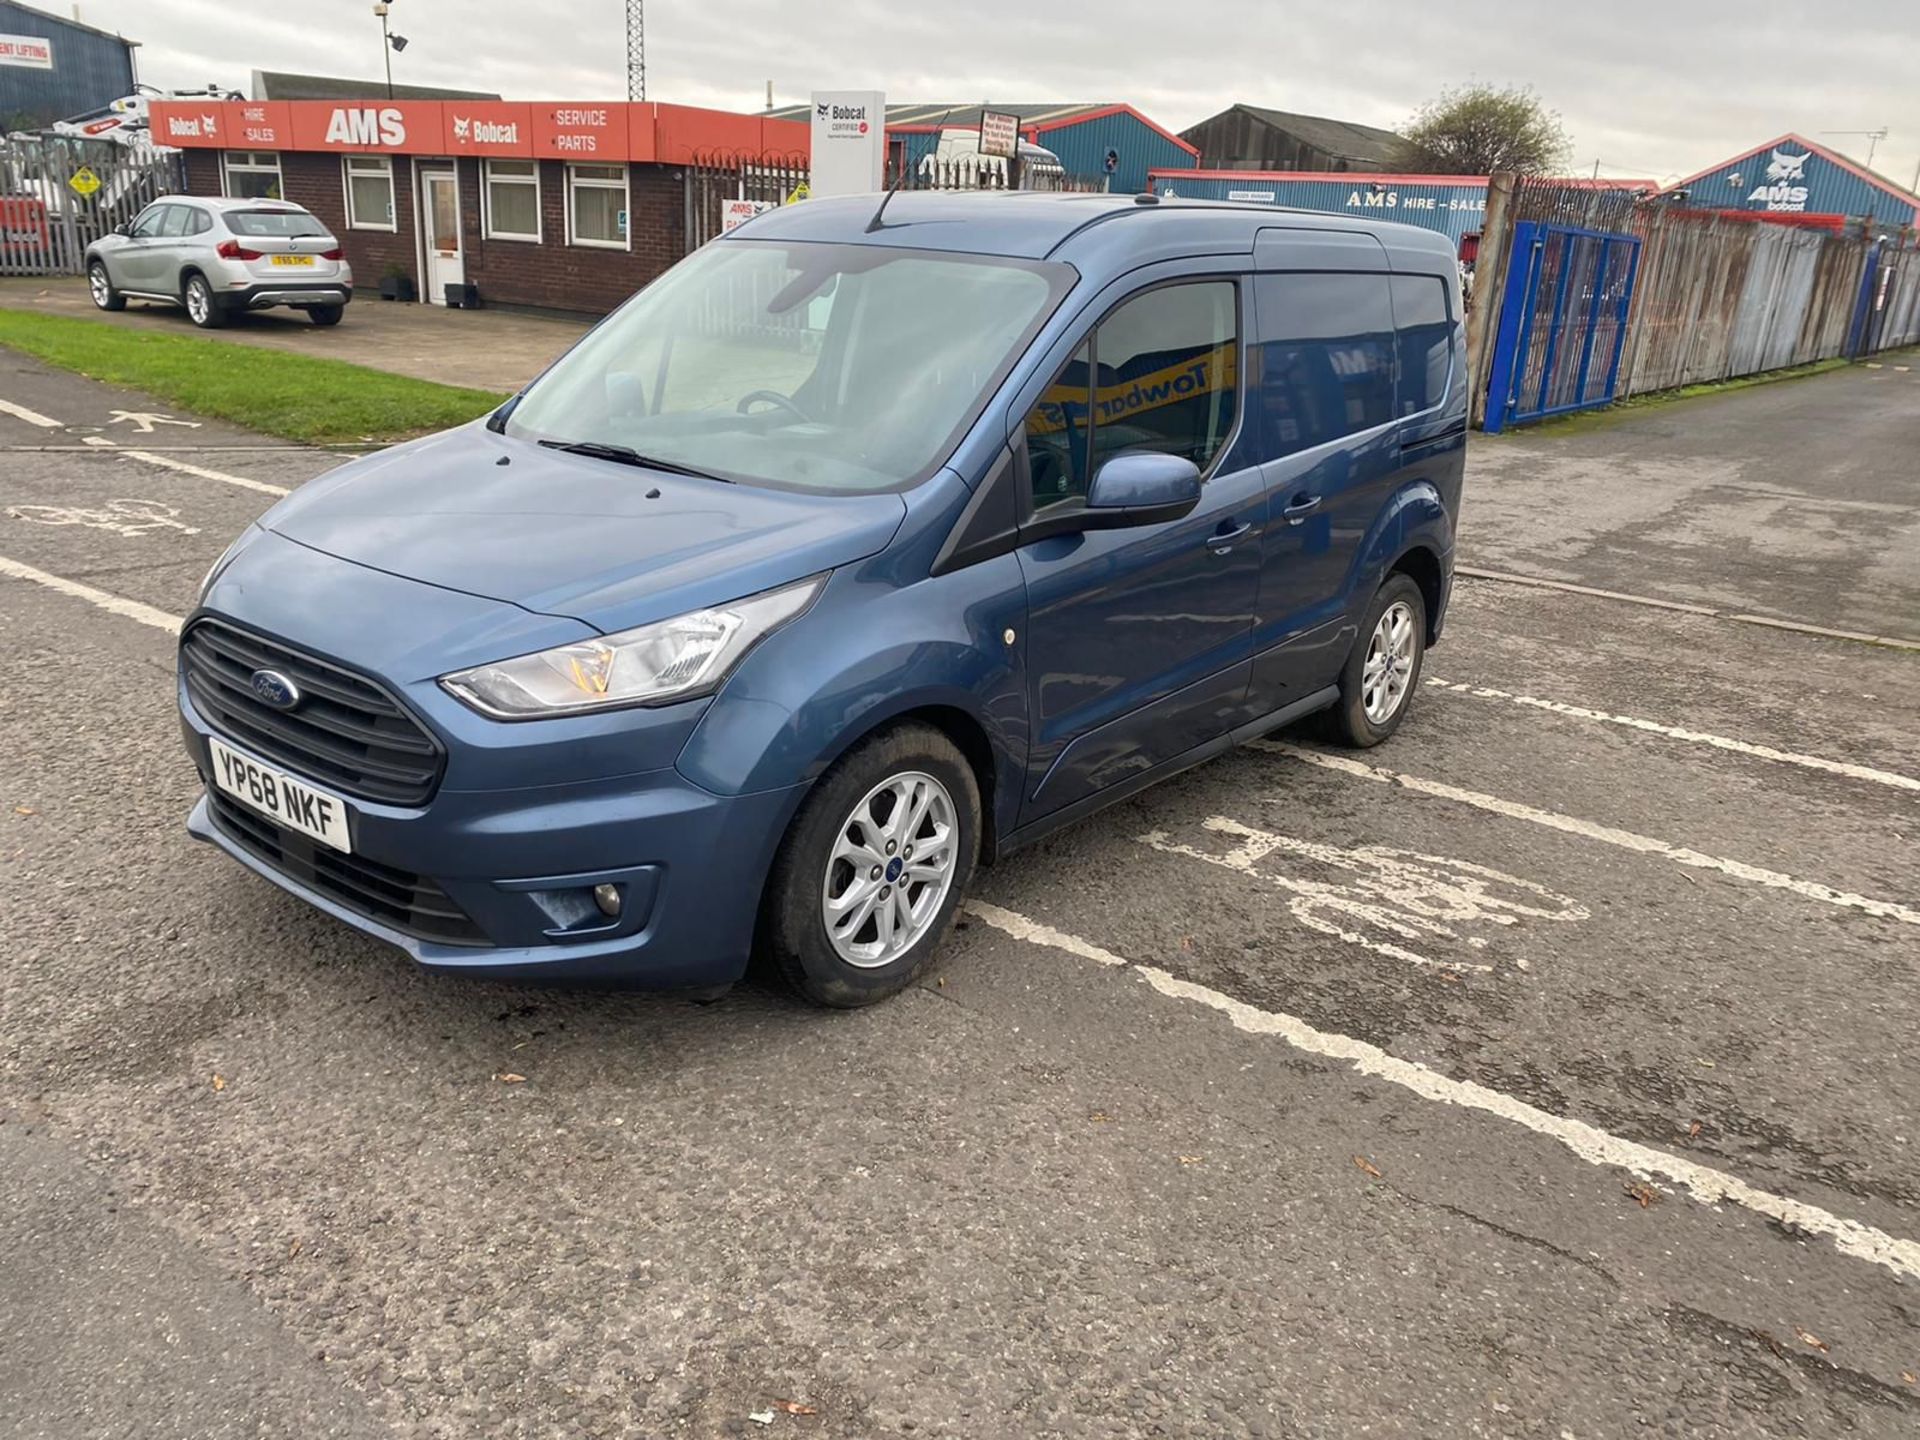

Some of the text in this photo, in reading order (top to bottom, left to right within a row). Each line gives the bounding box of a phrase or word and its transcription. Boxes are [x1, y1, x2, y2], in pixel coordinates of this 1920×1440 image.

[17, 44, 48, 59] LIFTING
[243, 107, 265, 122] HIRE
[556, 110, 607, 127] SERVICE
[832, 105, 865, 120] Bobcat
[168, 117, 200, 136] Bobcat
[325, 108, 406, 146] AMS
[473, 120, 518, 144] Bobcat
[246, 128, 274, 142] SALES
[557, 135, 596, 151] PARTS
[1346, 191, 1398, 208] AMS
[1403, 197, 1436, 210] HIRE
[1747, 186, 1809, 201] AMS
[729, 202, 752, 215] AMS
[218, 747, 332, 835] YP68 NKF
